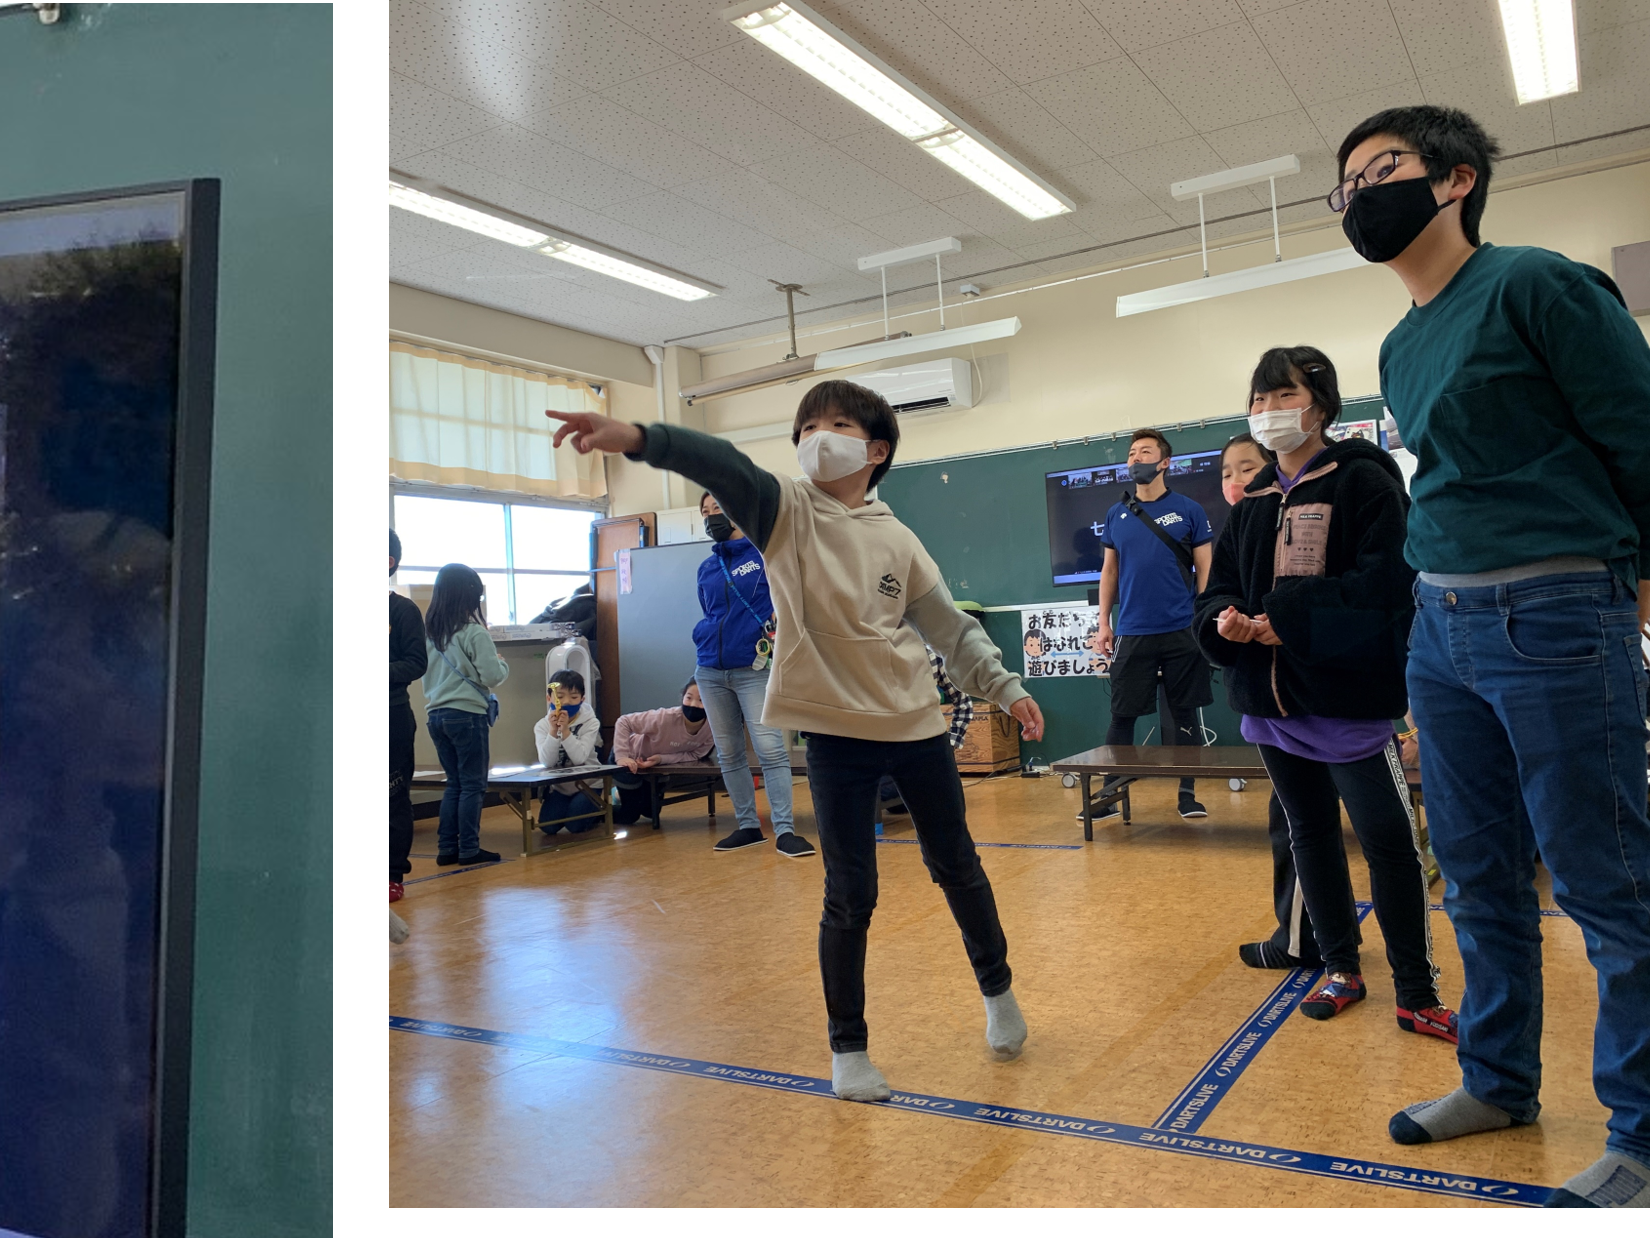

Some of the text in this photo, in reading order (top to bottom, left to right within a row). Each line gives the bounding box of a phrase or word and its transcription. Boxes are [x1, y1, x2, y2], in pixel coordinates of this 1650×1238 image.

[1028, 659, 1111, 677] 遊びましょう
[1263, 991, 1298, 1021] DARTSLIVE
[1221, 1031, 1263, 1068] DARTSLIVE
[703, 1065, 793, 1085] DARTSLIVE
[974, 1107, 1087, 1131] DARTSLIVE
[1170, 1083, 1220, 1130] DARTSLIVE
[1139, 1132, 1266, 1160] DARTSLIVE
[1329, 1161, 1477, 1192] DARTSLIVE
